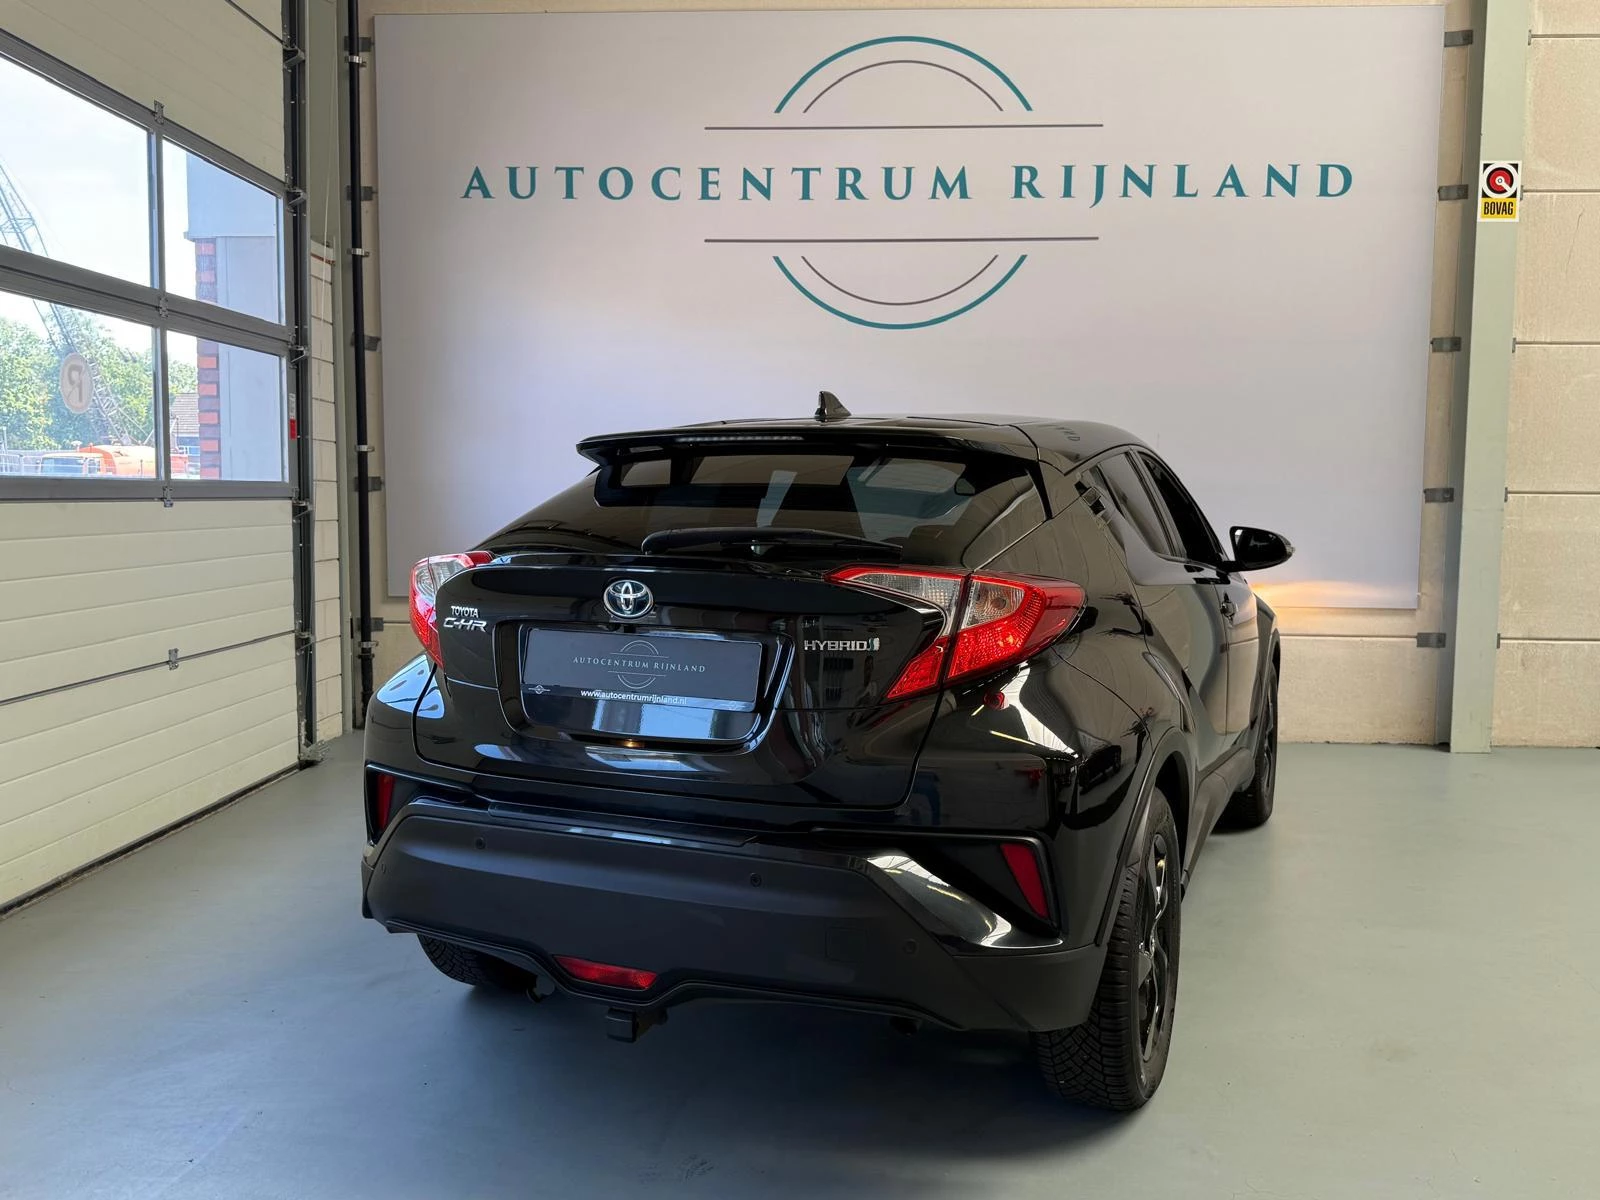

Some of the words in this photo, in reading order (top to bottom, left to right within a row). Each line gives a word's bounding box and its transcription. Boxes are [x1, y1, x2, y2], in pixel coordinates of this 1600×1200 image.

[460, 165, 972, 200] AUTOCENTRUM
[1010, 163, 1353, 208] RIJNLAND
[1483, 201, 1514, 215] BOVAG
[451, 605, 479, 618] TOYOTA
[443, 617, 487, 633] C-HR
[803, 639, 868, 651] HYBRID
[573, 656, 649, 669] AUTOCENTRUM
[653, 662, 707, 673] RIJNLAND
[580, 690, 687, 705] www.autocentrumrijnland.nl
